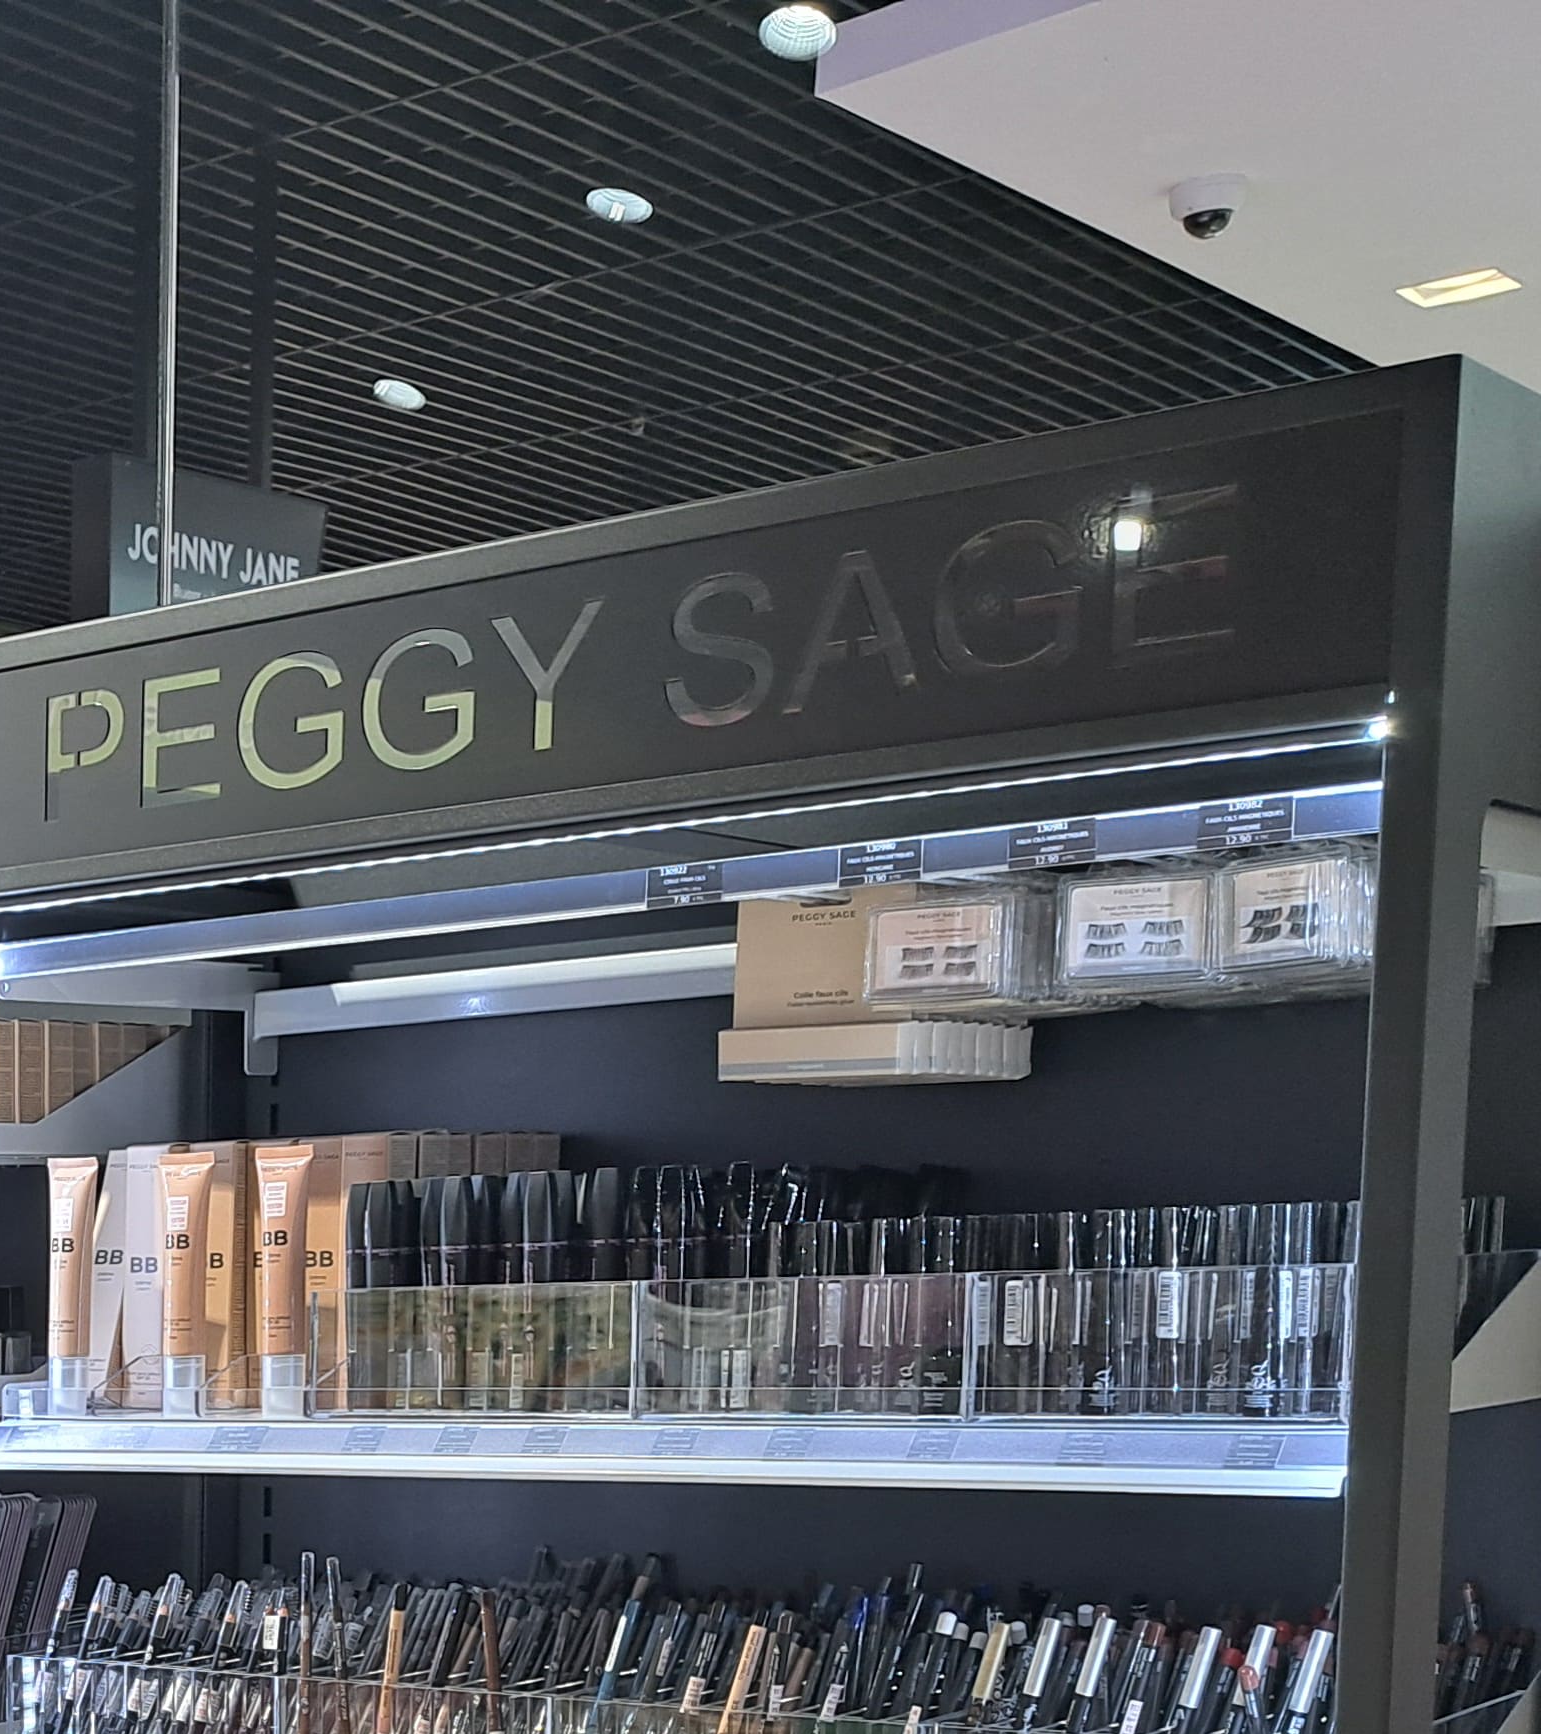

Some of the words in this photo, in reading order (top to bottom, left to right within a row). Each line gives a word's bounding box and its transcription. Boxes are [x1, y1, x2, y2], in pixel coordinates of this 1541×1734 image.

[127, 523, 235, 580] JOHNNY
[239, 548, 301, 586] JANE
[43, 600, 606, 822] PEGGY
[662, 484, 1239, 731] SAGE
[1225, 834, 1251, 845] 12.90
[1034, 855, 1059, 865] 12.90
[791, 912, 825, 923] PEGGY
[827, 909, 857, 920] SAGE
[166, 1233, 190, 1249] BB
[263, 1230, 288, 1246] BB
[94, 1250, 124, 1265] BB
[129, 1256, 159, 1273] BB
[305, 1251, 334, 1267] BB
